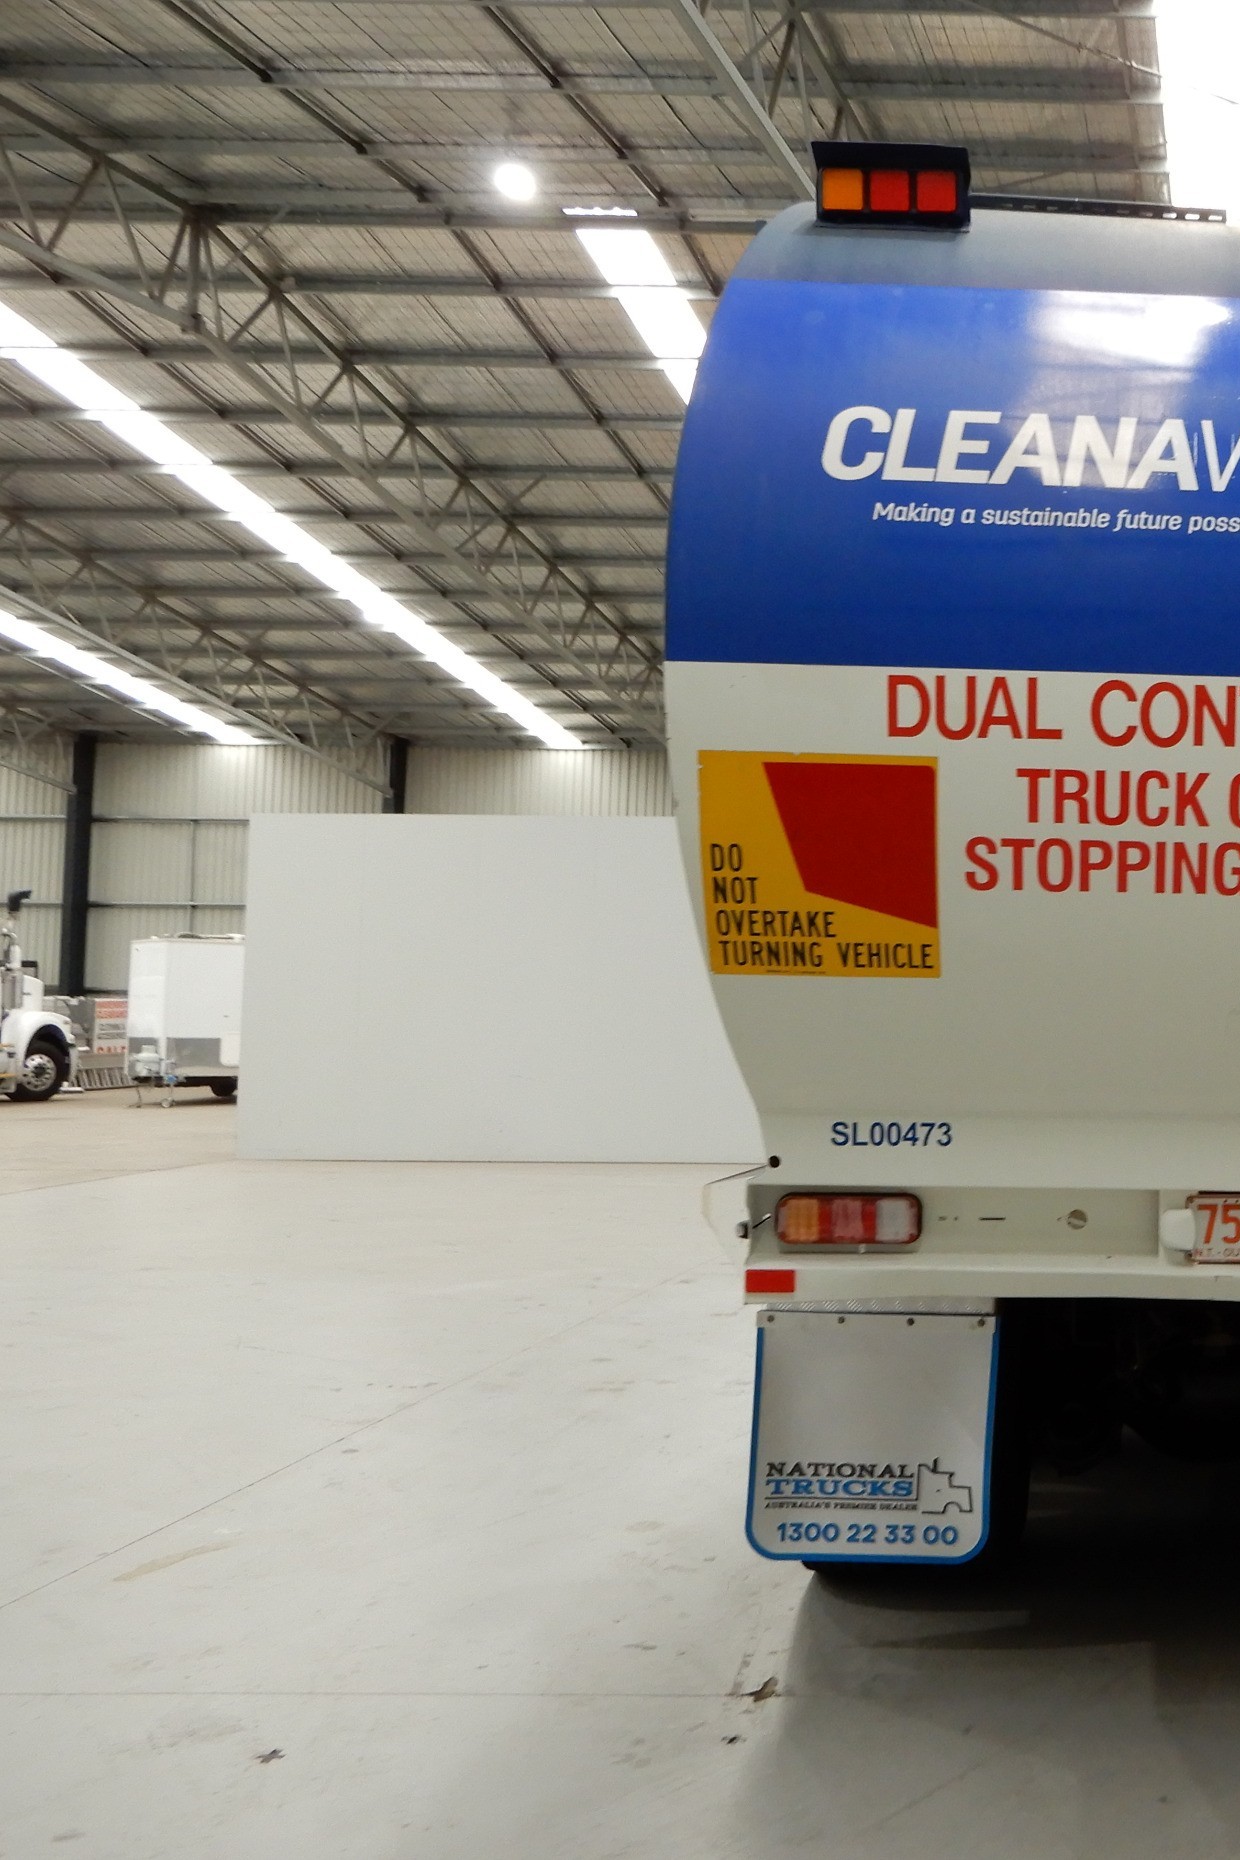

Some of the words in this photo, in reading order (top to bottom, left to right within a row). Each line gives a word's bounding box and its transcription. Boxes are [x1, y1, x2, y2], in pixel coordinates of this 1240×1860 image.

[872, 502, 955, 527] Making
[960, 510, 976, 524] a
[981, 508, 1110, 529] sustainable
[1113, 509, 1183, 532] future
[887, 674, 1063, 741] DUAL
[1016, 768, 1210, 828] TRUCK
[710, 843, 743, 872] DO
[713, 876, 759, 904] NOT
[716, 909, 837, 938] OVERTAKE
[718, 940, 824, 967] TURNING
[836, 942, 935, 969] VEHICLE
[830, 1121, 953, 1147] SL00473
[765, 1462, 915, 1479] NATIONAL
[766, 1478, 914, 1497] TRUCKS
[777, 1521, 840, 1543] 1300
[846, 1523, 877, 1543] 22
[884, 1524, 916, 1544] 33
[922, 1525, 959, 1545] 00
